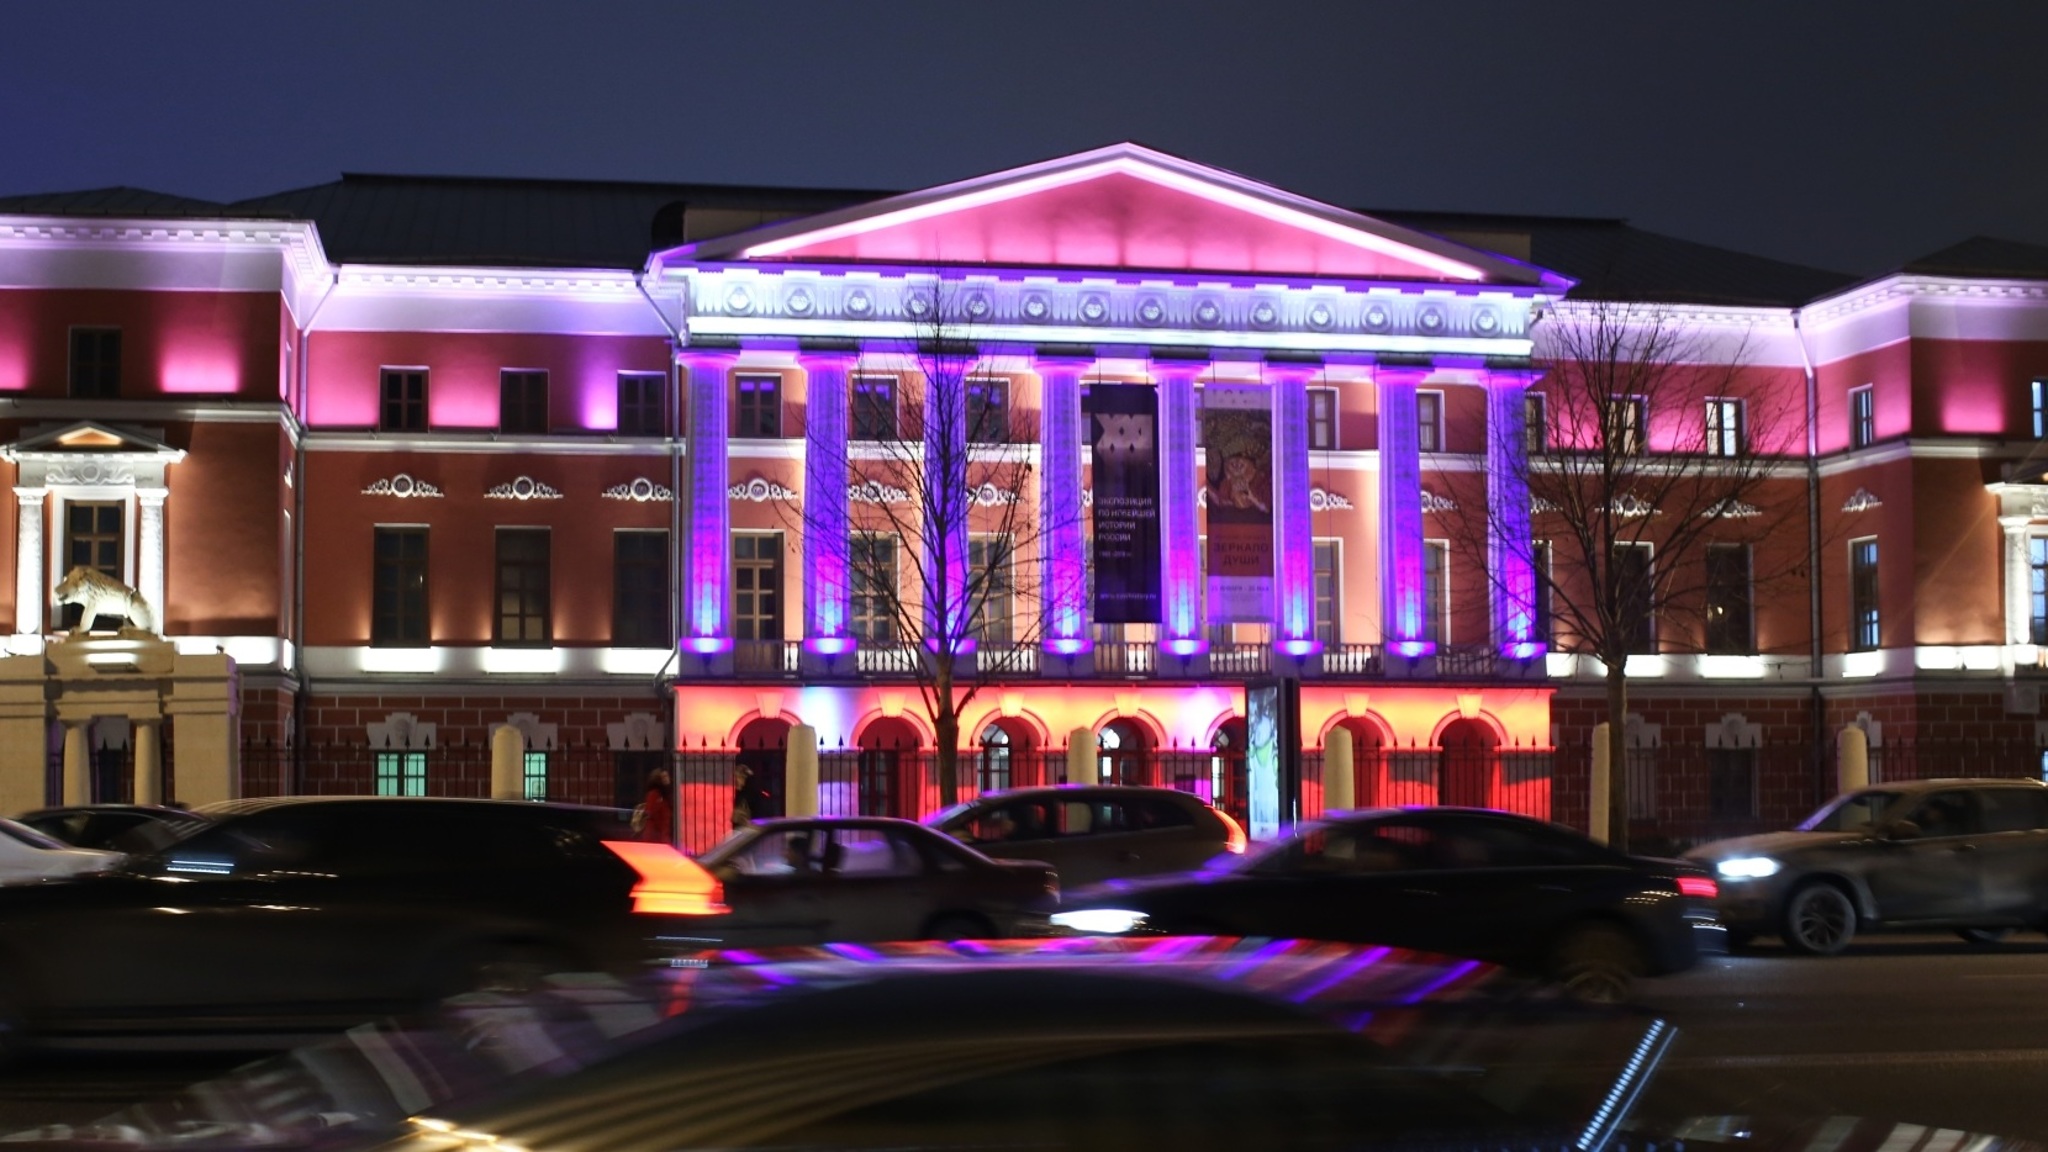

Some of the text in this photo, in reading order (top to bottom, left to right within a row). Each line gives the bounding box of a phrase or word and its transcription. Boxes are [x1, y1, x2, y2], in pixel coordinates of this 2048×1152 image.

[1098, 521, 1136, 530] ИСТОРИИ
[1098, 532, 1131, 542] РОССИИ
[1213, 542, 1269, 553] ЗЕРКАЛО
[1222, 554, 1260, 566] ДУШИ
